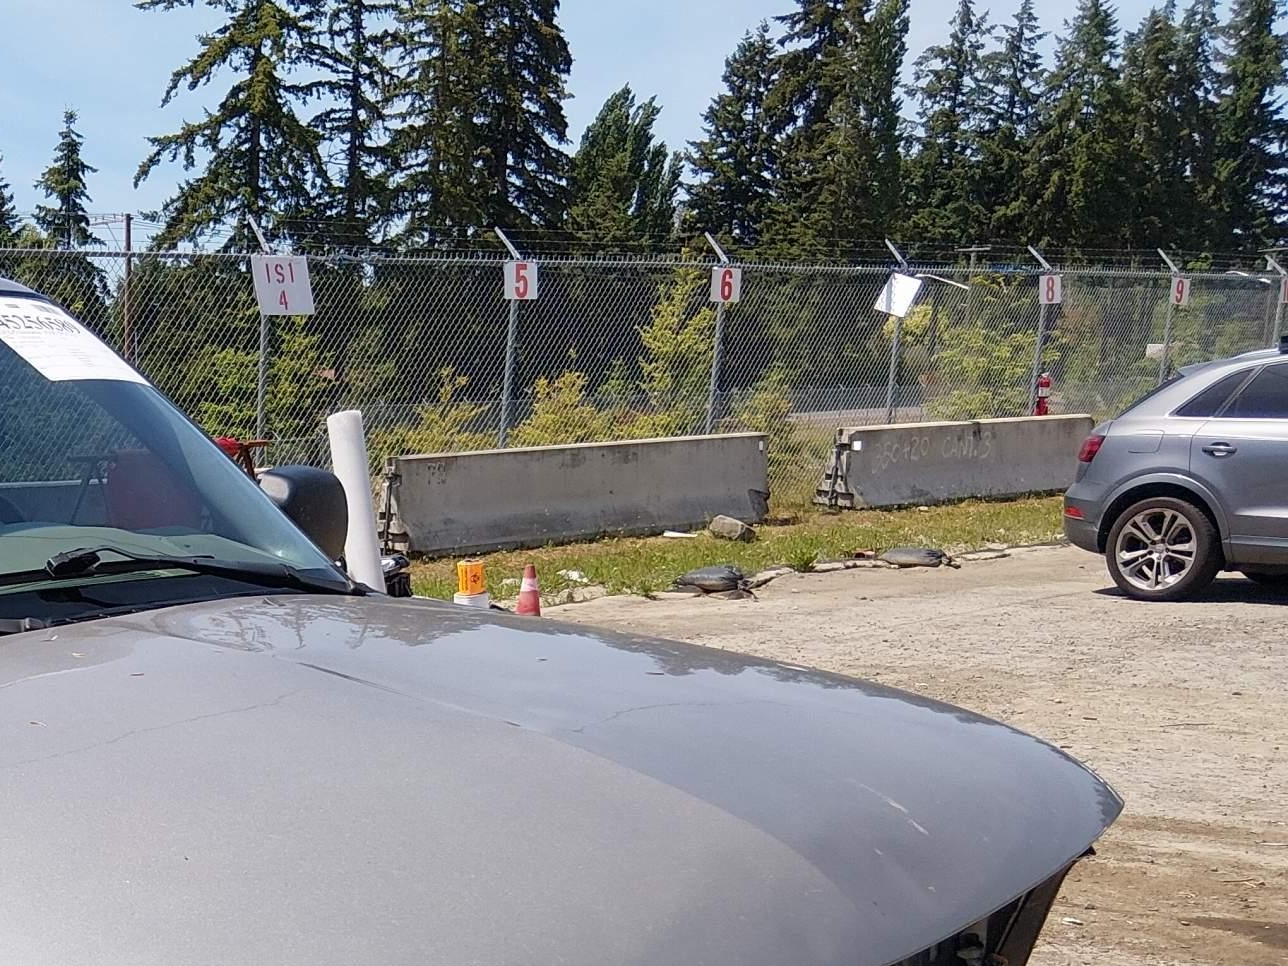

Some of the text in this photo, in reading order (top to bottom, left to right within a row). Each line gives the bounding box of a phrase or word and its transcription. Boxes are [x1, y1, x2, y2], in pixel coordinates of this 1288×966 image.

[514, 263, 529, 299] 5
[719, 268, 733, 302] 6
[1046, 276, 1055, 302] 8
[1175, 279, 1185, 303] 9
[279, 290, 289, 310] 4
